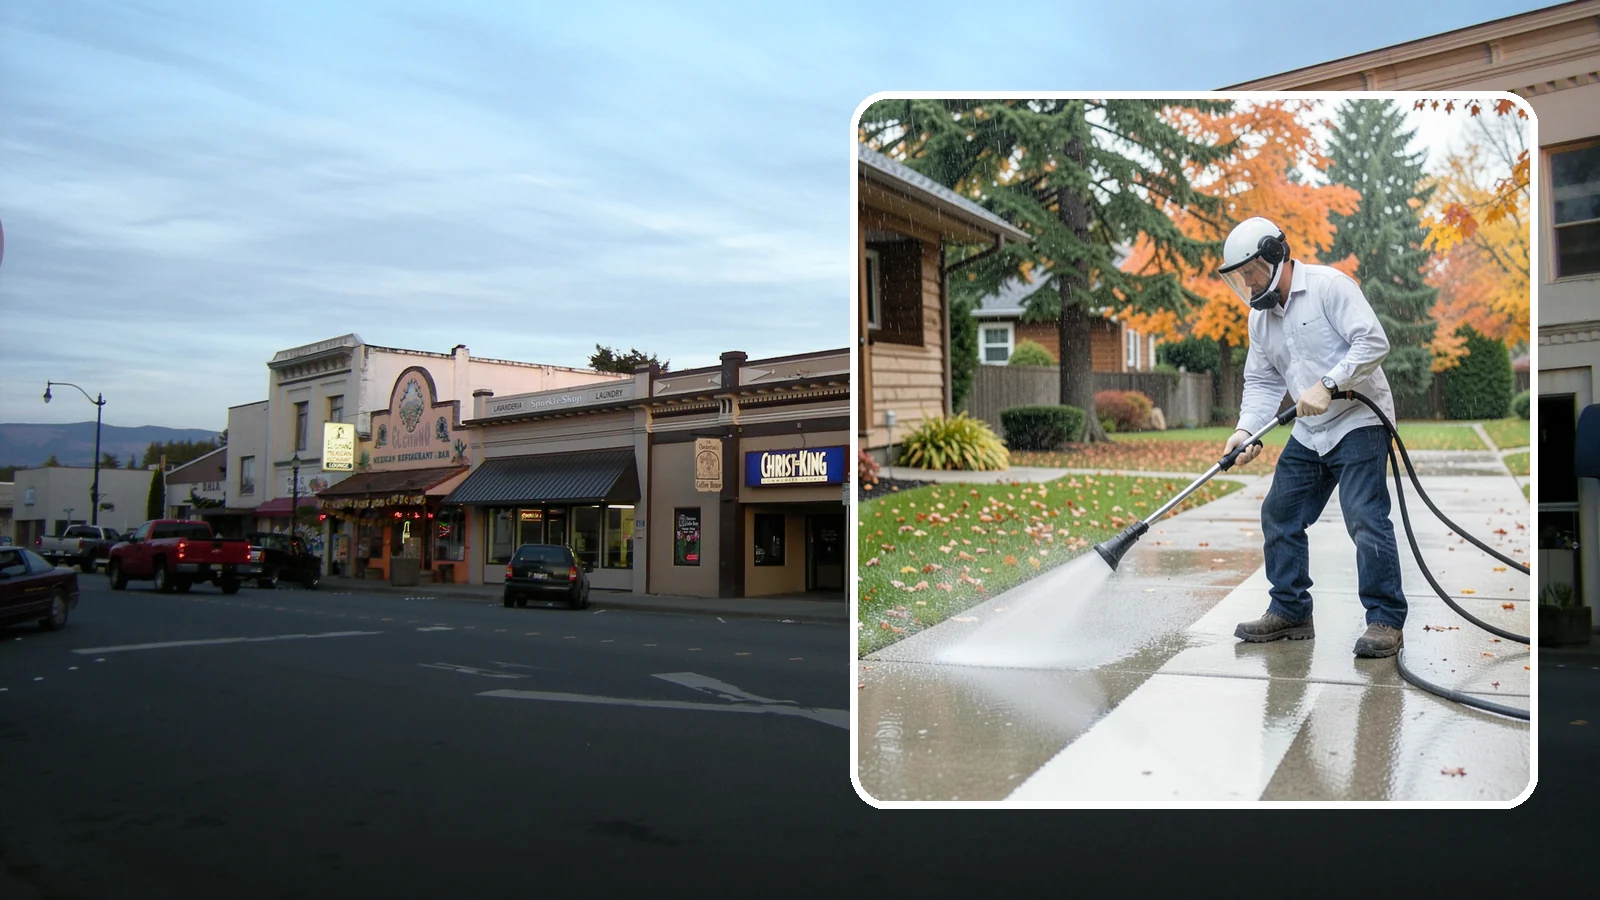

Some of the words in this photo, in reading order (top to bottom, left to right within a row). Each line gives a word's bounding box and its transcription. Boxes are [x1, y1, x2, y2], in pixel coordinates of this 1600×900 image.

[561, 394, 582, 405] Shop
[595, 389, 623, 400] LAUNDRY
[493, 402, 522, 412] LAVANDERIA
[374, 454, 396, 464] MEXICAN
[398, 451, 433, 462] RESTAURANT
[438, 450, 450, 459] BAR
[761, 452, 797, 478] CHRIST
[799, 450, 827, 476] KING
